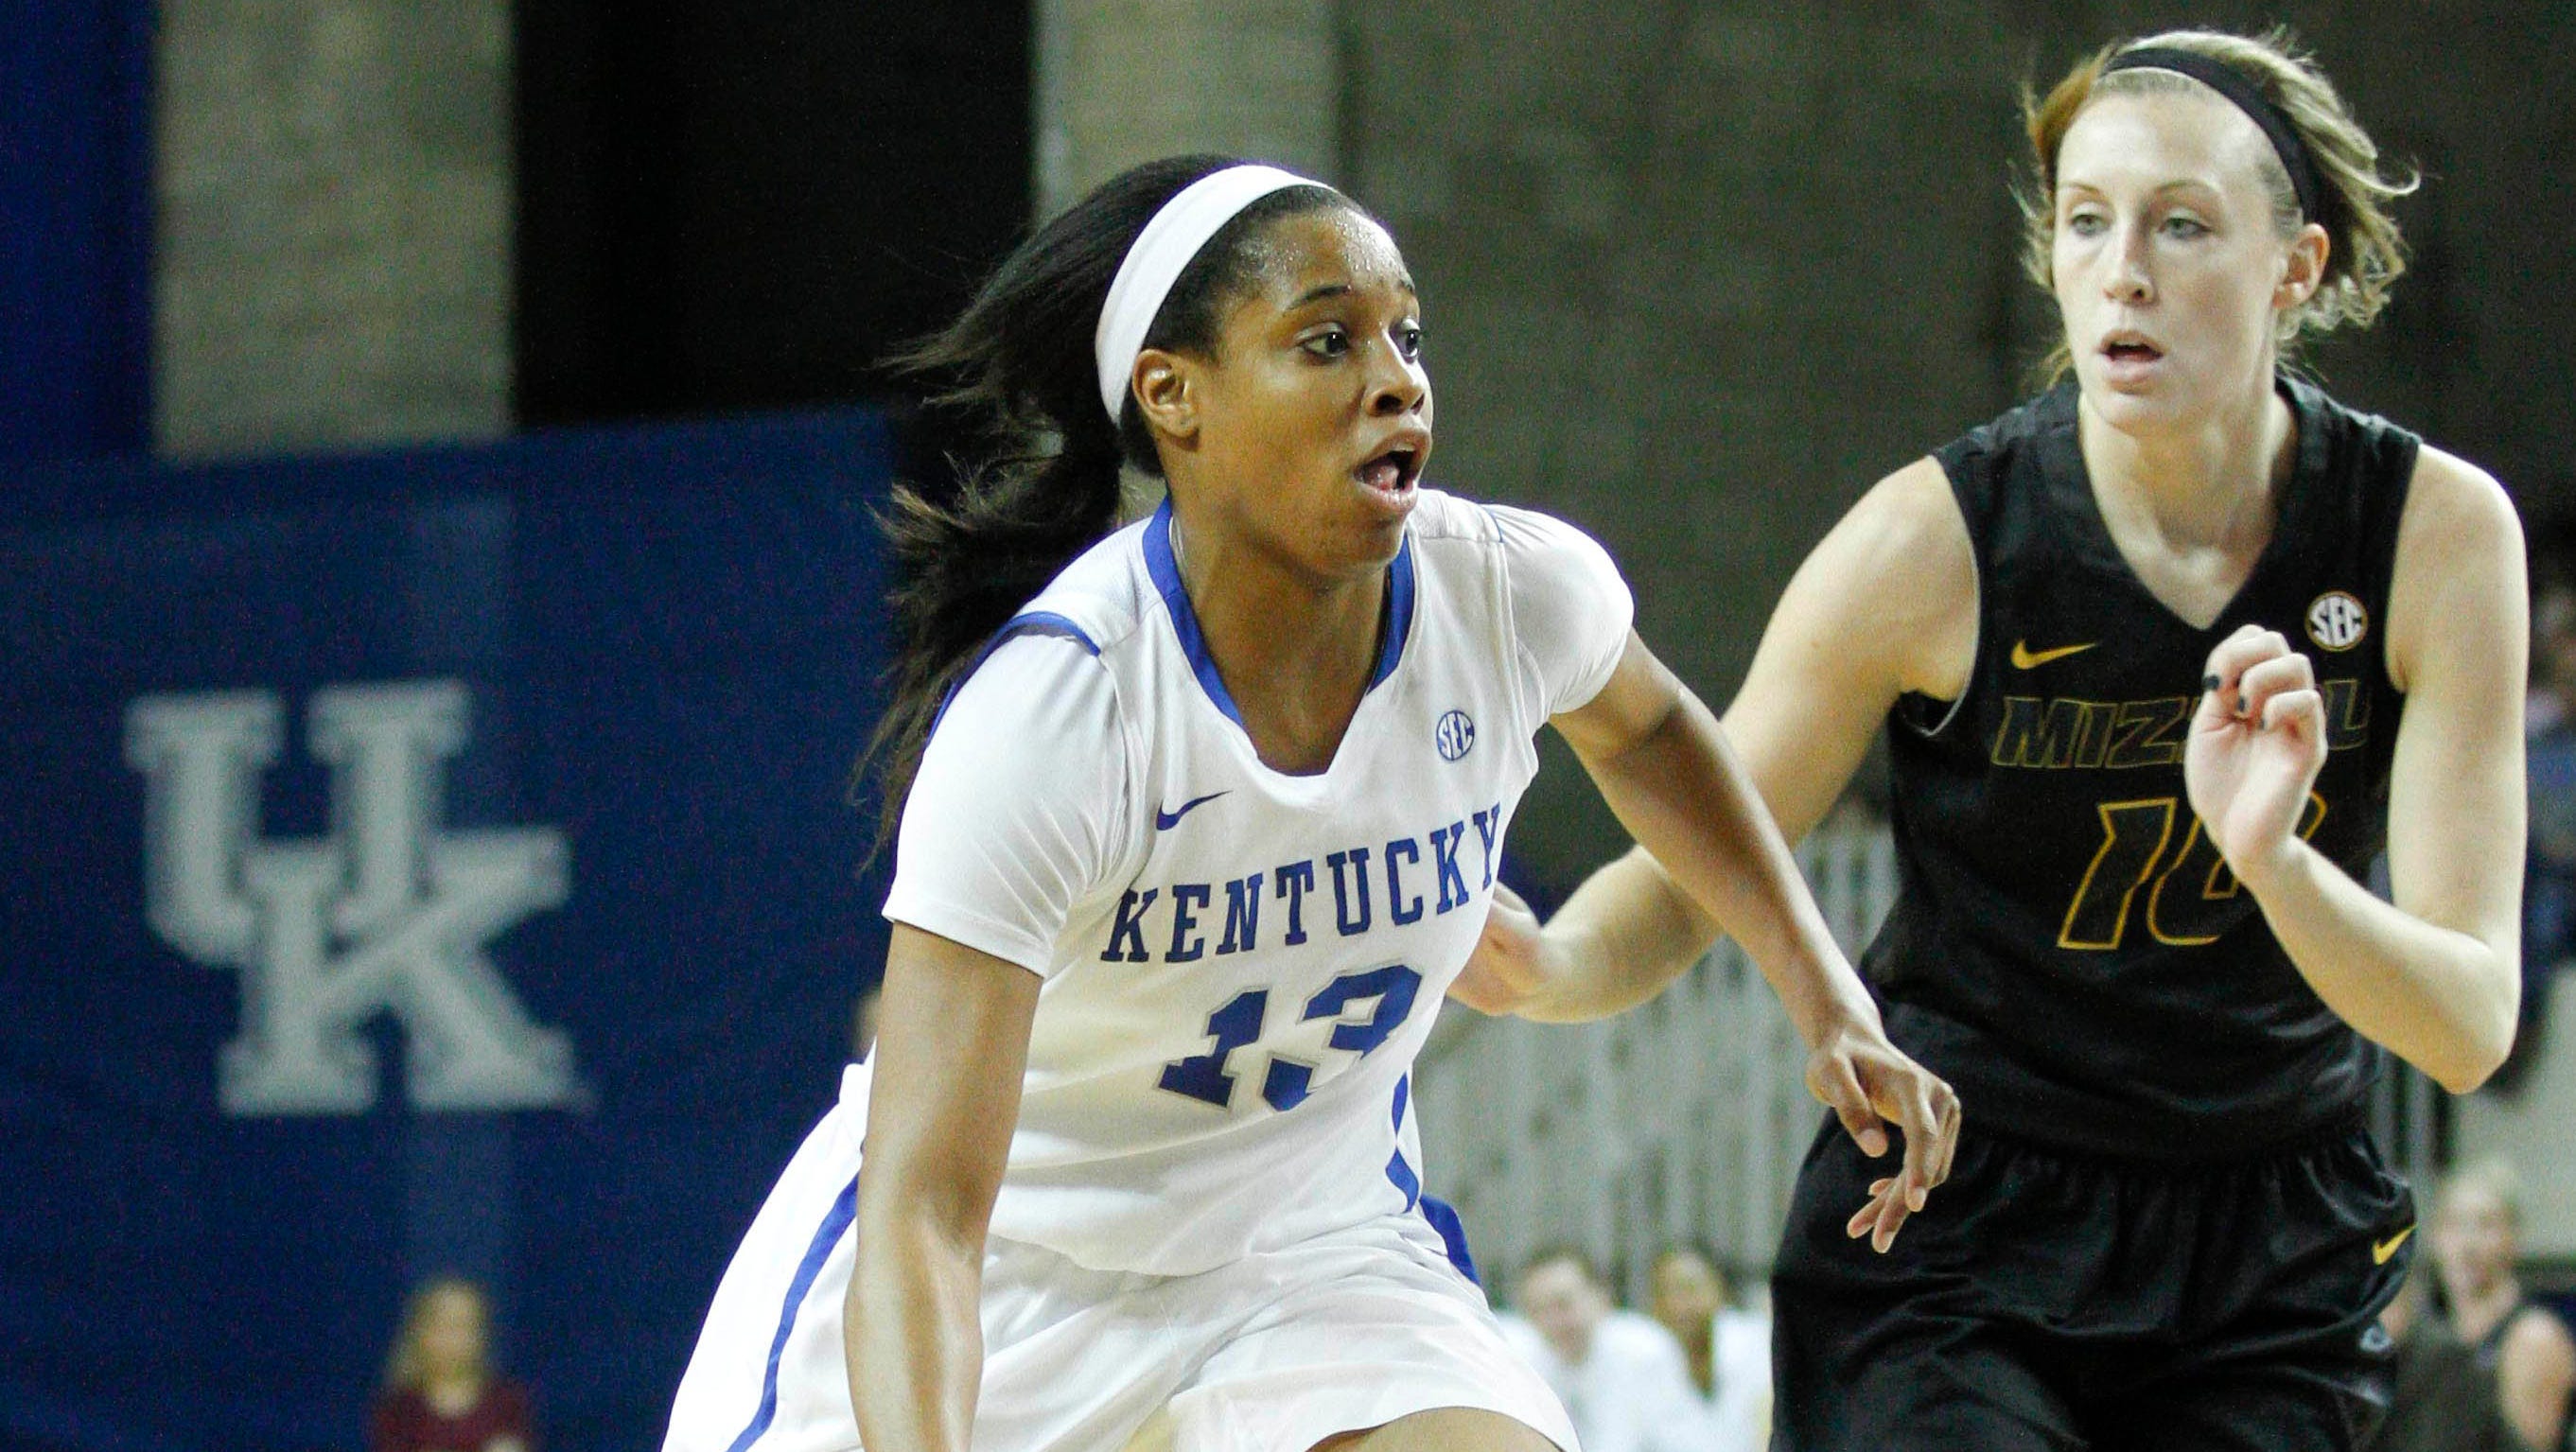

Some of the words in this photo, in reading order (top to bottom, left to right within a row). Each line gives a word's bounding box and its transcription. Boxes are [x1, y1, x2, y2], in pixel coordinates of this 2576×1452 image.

[2306, 591, 2367, 652] SEC
[1437, 709, 1475, 761] SEC
[124, 678, 573, 1116] UK
[1100, 802, 1500, 963] KENTUCKY
[1153, 960, 1423, 1112] 13
